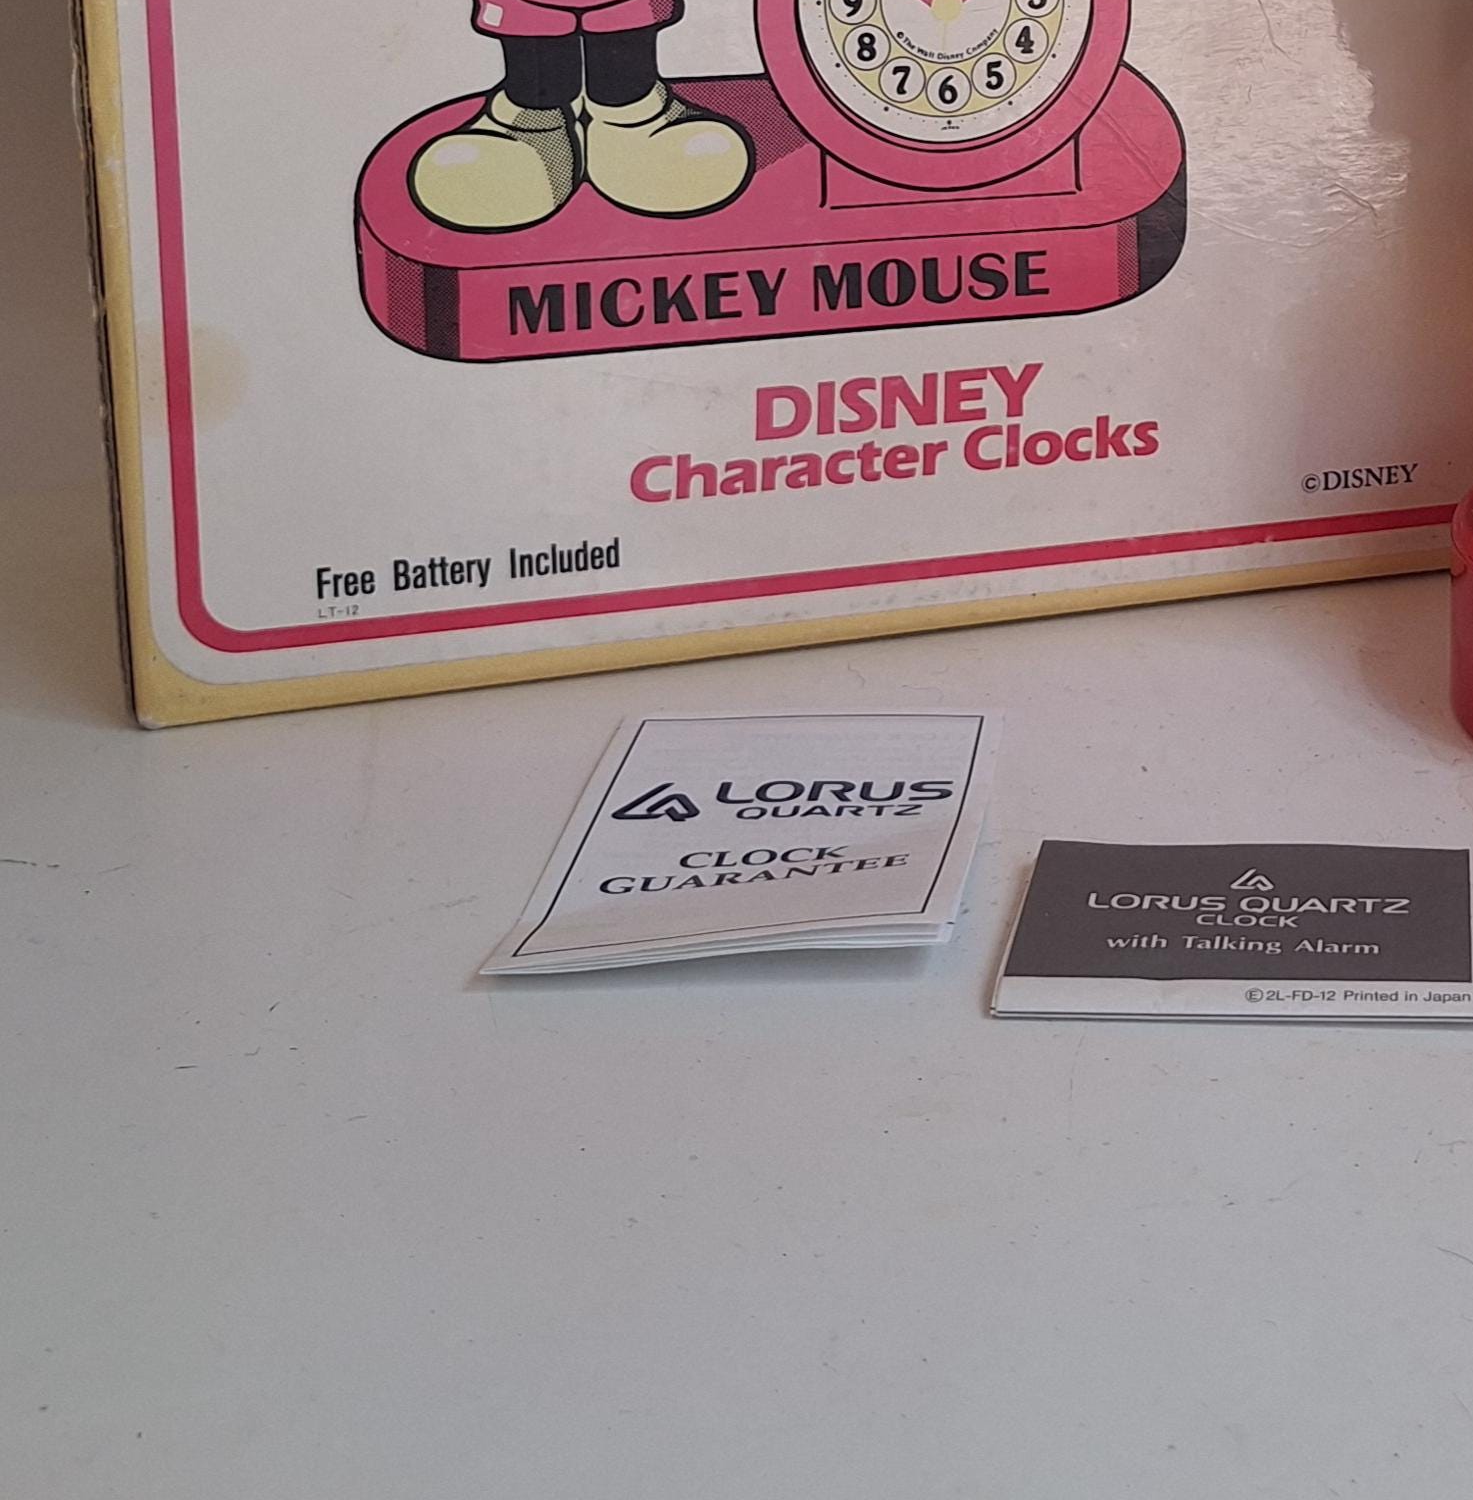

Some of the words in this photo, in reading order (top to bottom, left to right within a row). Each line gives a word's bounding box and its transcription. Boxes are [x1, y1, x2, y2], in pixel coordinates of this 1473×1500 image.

[857, 32, 876, 62] 8
[1015, 25, 1035, 54] 4
[892, 66, 911, 95] 7
[938, 74, 958, 105] 6
[986, 60, 1004, 90] 5
[508, 267, 787, 336] MICKEY
[813, 250, 1050, 312] MOUSE
[755, 362, 1044, 441] DISNEY
[630, 440, 949, 503] Character
[963, 415, 1160, 471] Clocks
[316, 566, 376, 600] Free
[393, 556, 491, 592] Battery
[509, 537, 621, 579] Included
[318, 605, 359, 619] LT-12
[715, 780, 954, 804] LORUS
[735, 803, 923, 820] QUARTZ
[679, 846, 849, 870] CLOCK
[599, 853, 910, 895] GUARANTEE
[1087, 892, 1226, 912] LORUS
[1240, 895, 1411, 915] QUARTZ
[1196, 913, 1300, 928] CLOCK
[1106, 933, 1168, 950] with
[1182, 934, 1282, 955] Talking
[1295, 938, 1380, 955] Alarm
[1343, 989, 1399, 1002] Printed
[1405, 990, 1418, 1002] in
[1423, 991, 1472, 1004] Japan
